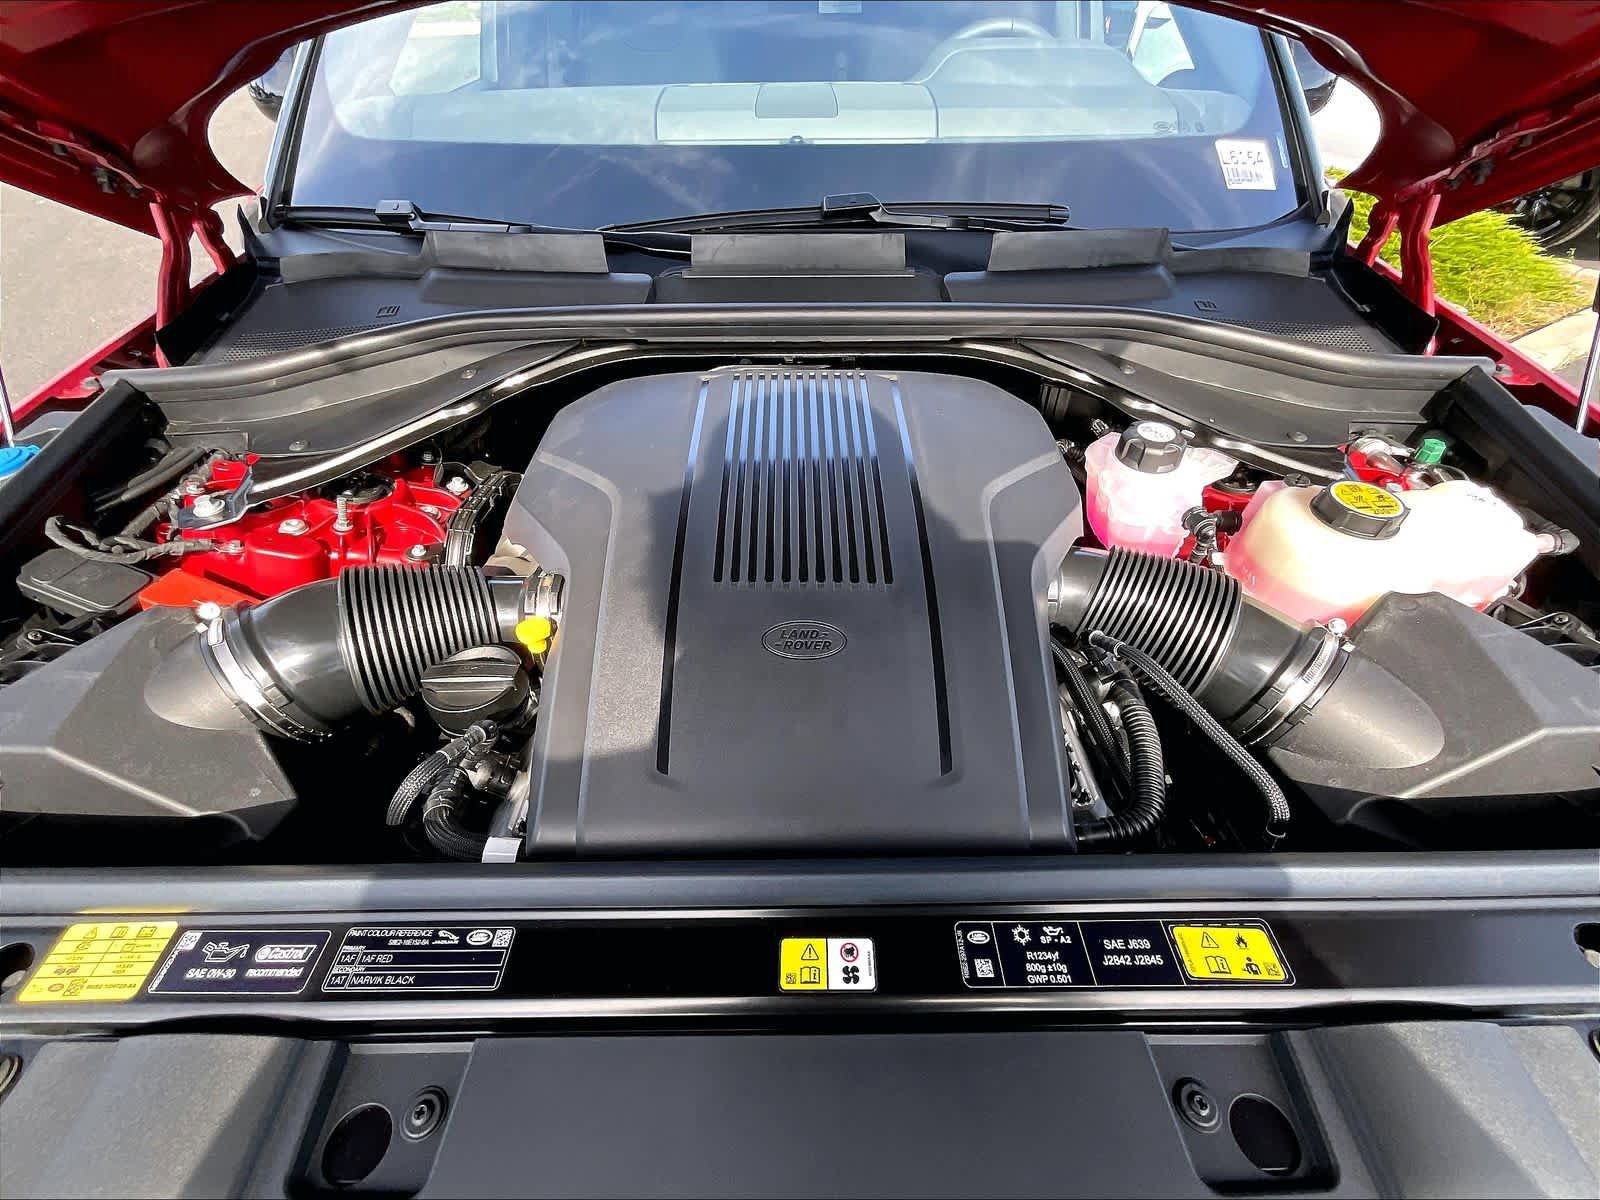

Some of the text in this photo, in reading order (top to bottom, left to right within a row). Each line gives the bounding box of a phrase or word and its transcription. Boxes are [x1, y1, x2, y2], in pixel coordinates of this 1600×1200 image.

[781, 629, 820, 639] LAND
[783, 640, 832, 650] ROVER
[348, 929, 434, 937] PAINT COLOUR REFERENCE
[1060, 936, 1072, 944] A2
[1103, 938, 1151, 950] SAE J639
[268, 948, 307, 960] Castrol
[341, 954, 357, 963] 1AF
[361, 954, 394, 963] 1AF RED
[1102, 954, 1164, 966] J2842 J2845
[185, 967, 207, 978] SAE
[245, 966, 304, 977] recommended
[330, 976, 347, 985] 1AT
[350, 976, 416, 985] NARVIK BLACK
[1027, 974, 1073, 984] GWP 0.501
